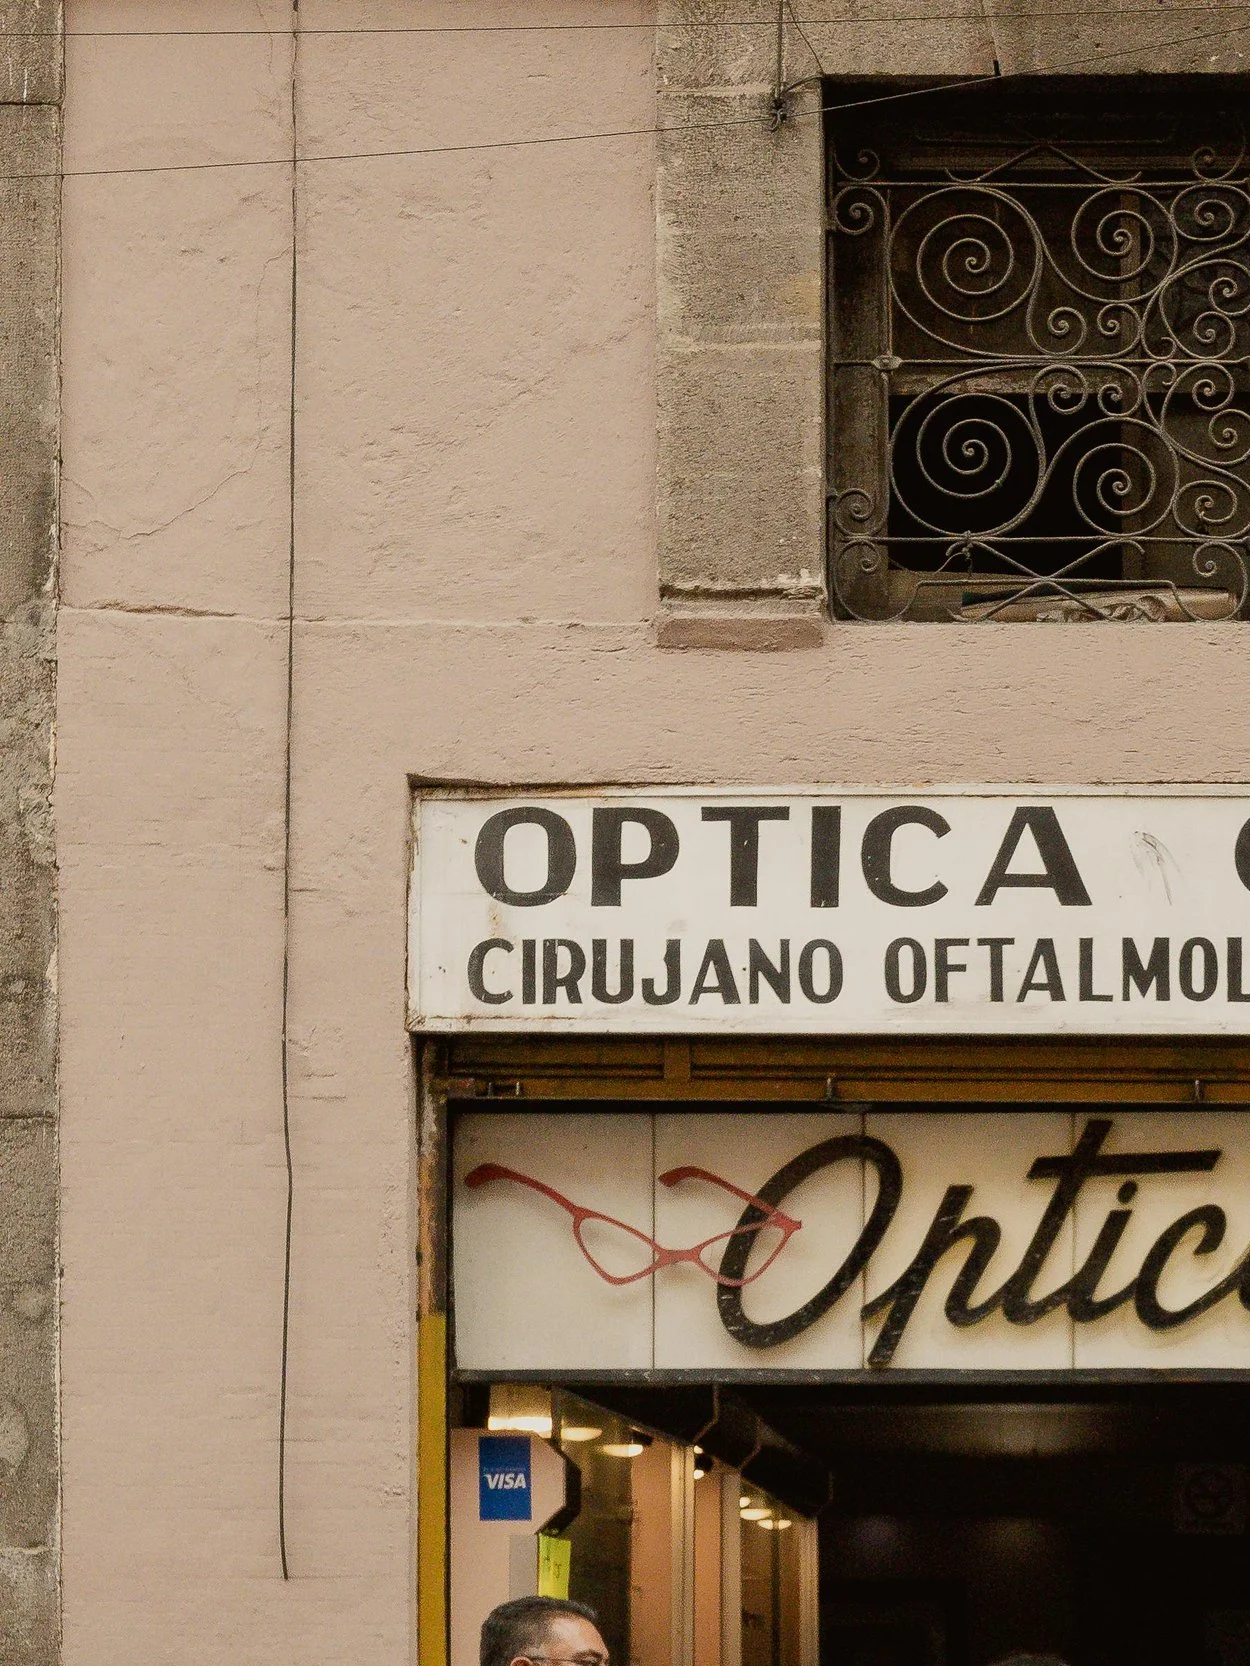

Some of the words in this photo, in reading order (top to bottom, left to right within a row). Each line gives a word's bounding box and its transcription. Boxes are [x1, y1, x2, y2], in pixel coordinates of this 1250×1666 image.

[474, 804, 1092, 908] OPTICA
[467, 937, 844, 1006] CIRUJANO
[483, 1472, 527, 1490] VISA
